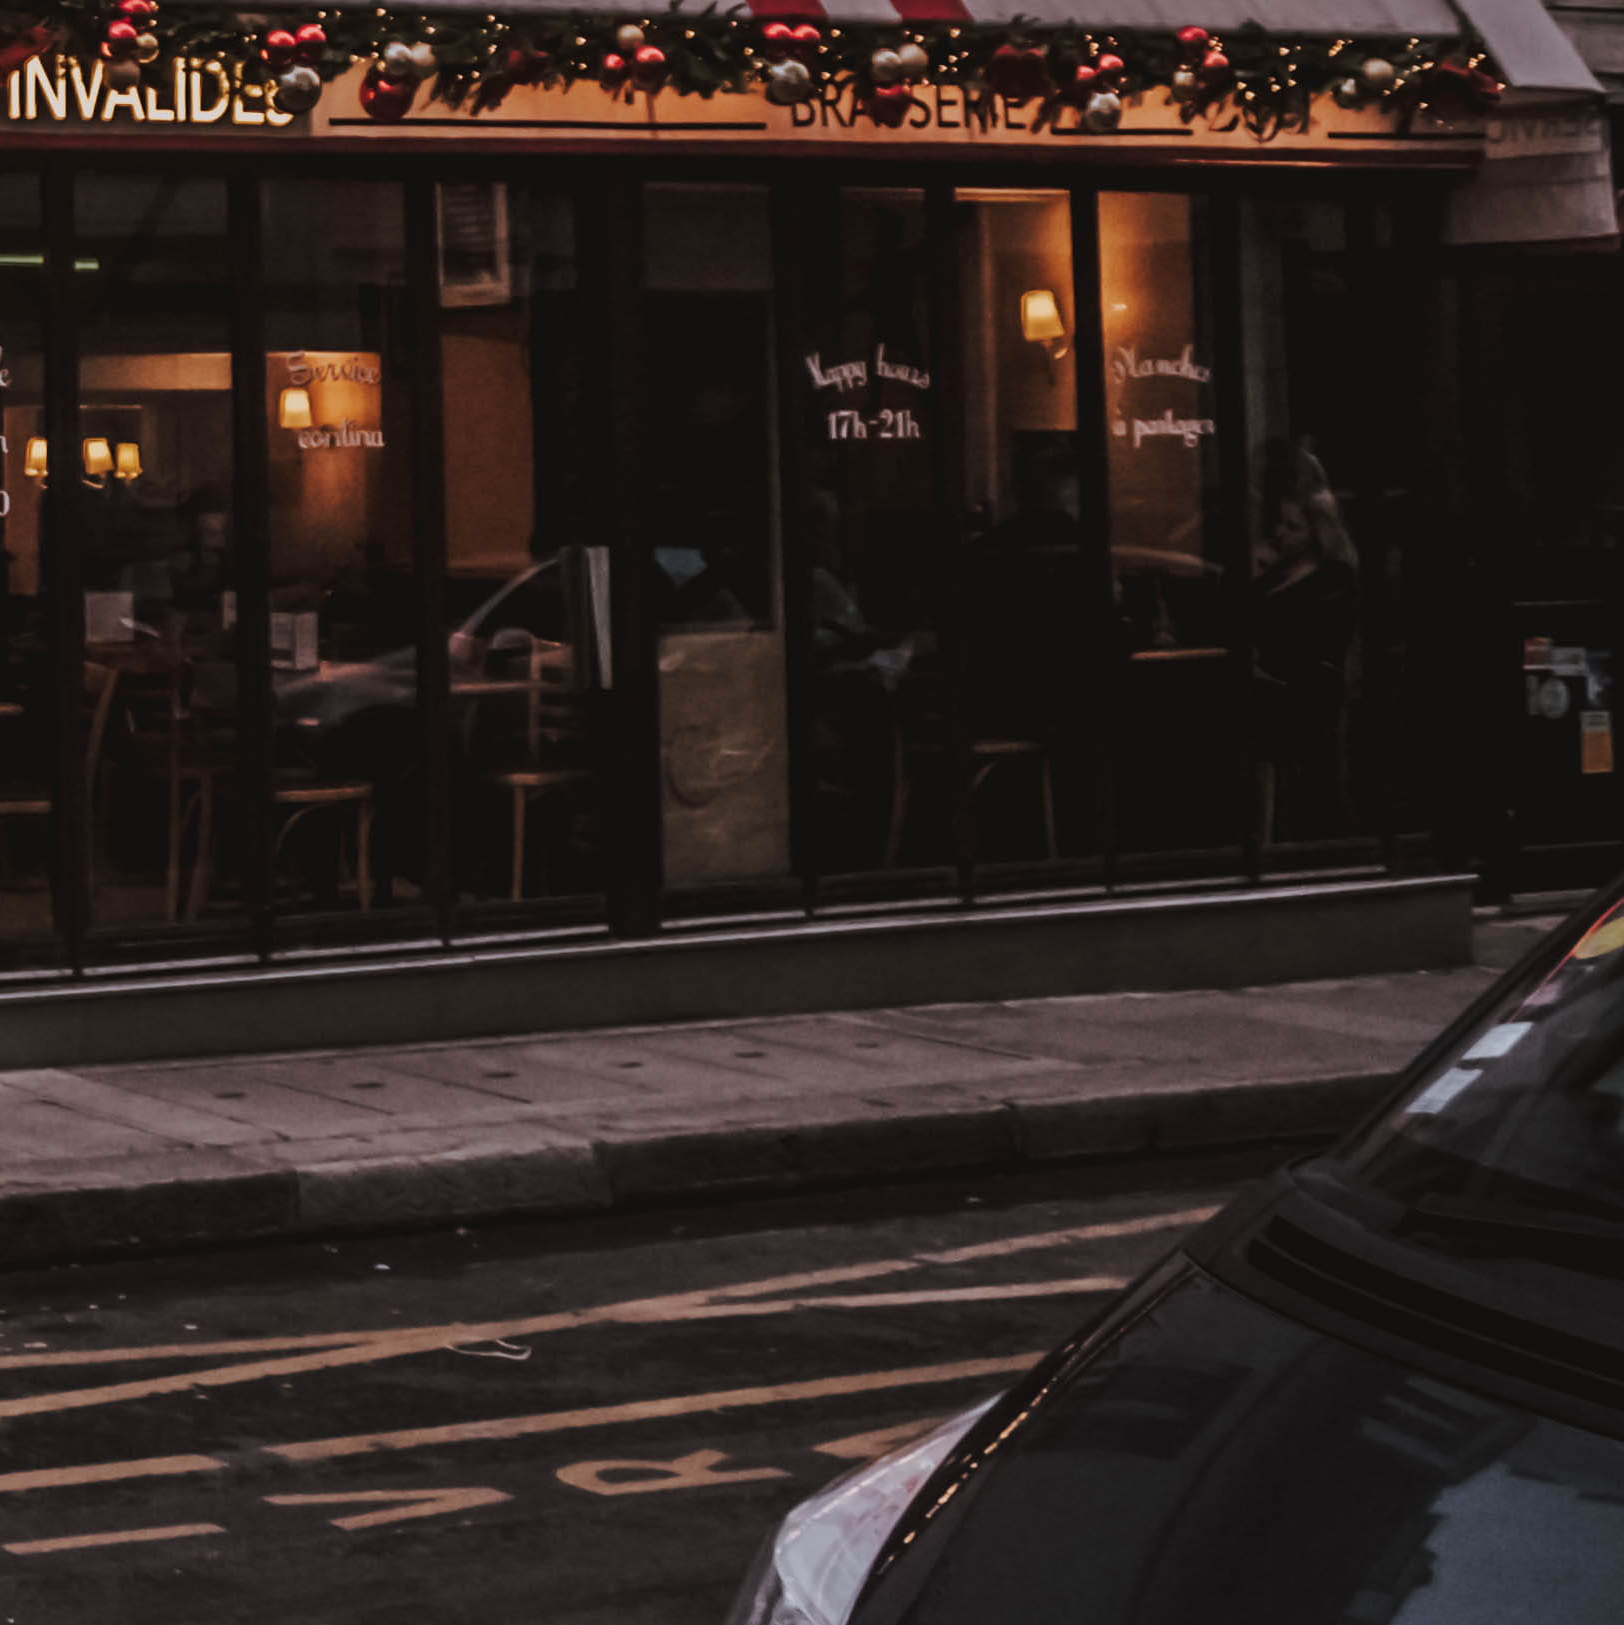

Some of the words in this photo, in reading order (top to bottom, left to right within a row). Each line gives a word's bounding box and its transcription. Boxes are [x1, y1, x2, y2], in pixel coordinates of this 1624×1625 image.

[790, 72, 1028, 130] BRASERIE
[297, 418, 385, 448] continu
[827, 408, 921, 439] 17h-21h
